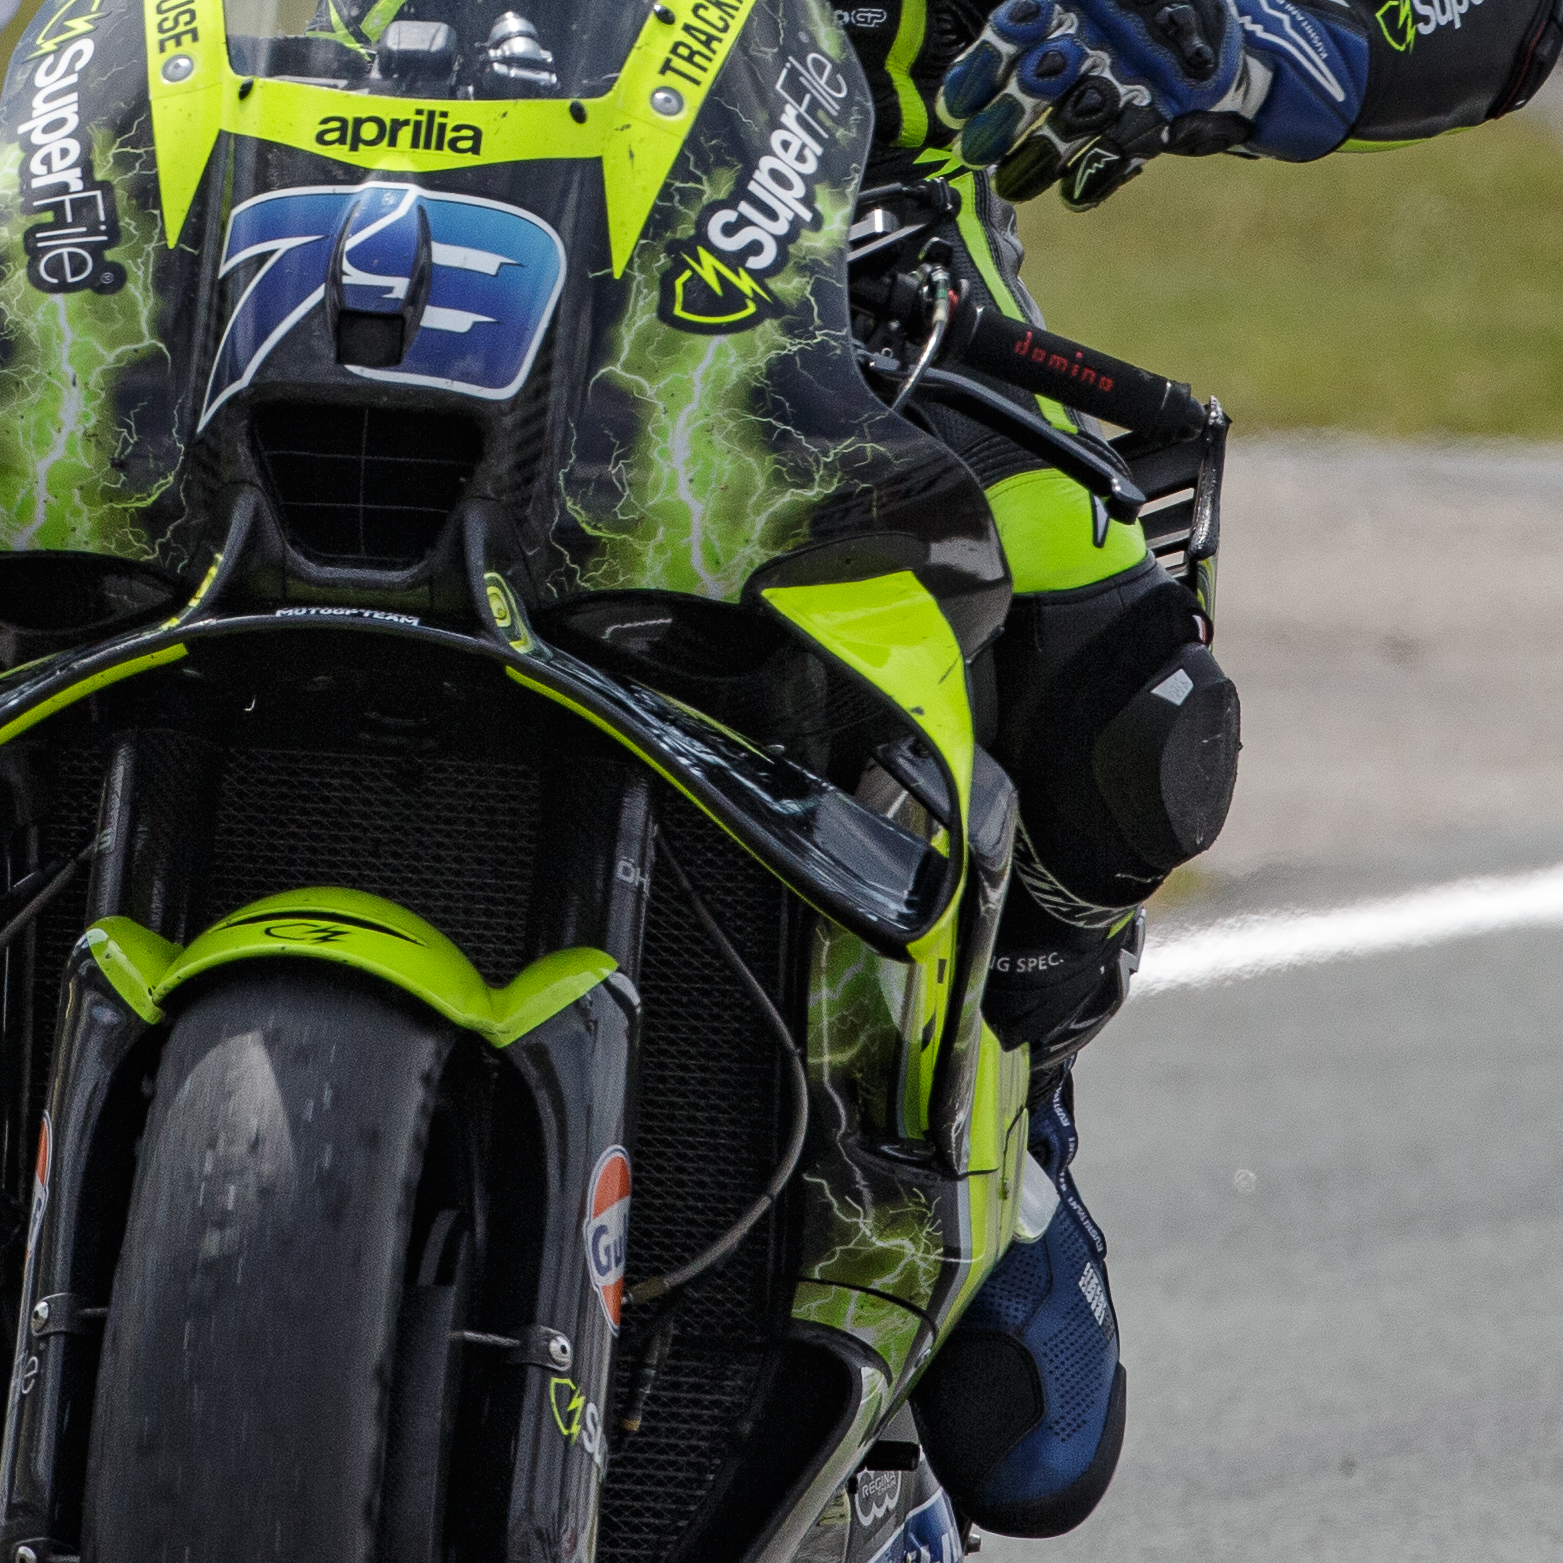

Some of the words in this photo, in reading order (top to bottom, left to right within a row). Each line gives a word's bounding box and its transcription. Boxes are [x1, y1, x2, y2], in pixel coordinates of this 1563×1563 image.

[18, 38, 109, 285] SuperFile
[315, 108, 484, 156] aprilia
[707, 51, 849, 271] SuperFile
[1014, 332, 1113, 392] domino
[862, 1471, 898, 1499] REGINA
